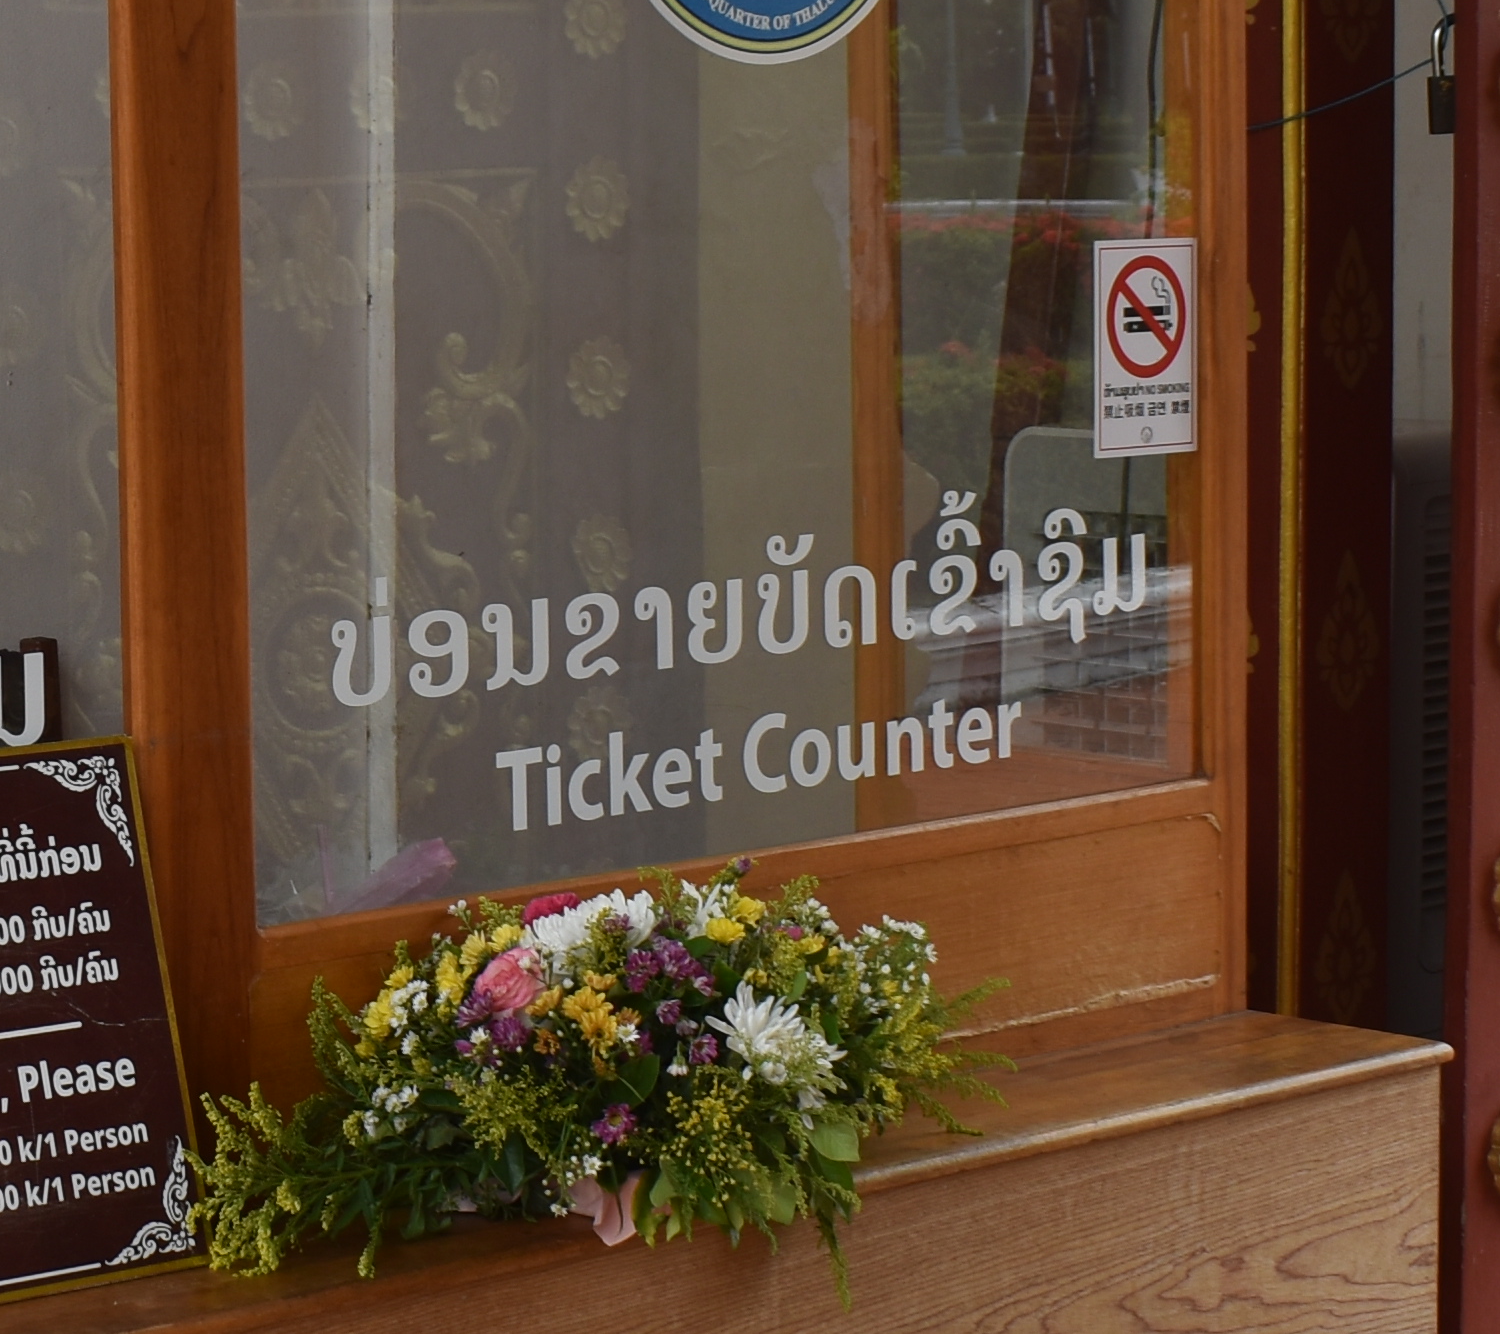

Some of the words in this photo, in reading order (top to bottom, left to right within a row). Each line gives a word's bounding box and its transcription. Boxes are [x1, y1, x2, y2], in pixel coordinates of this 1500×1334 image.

[772, 14, 792, 30] OF
[331, 490, 1146, 707] ບ່ອນຂາຍບັດເຂົ້າຊົມ
[495, 729, 722, 832] Ticket
[743, 698, 1022, 793] Counter
[32, 901, 111, 941] ກີບ/ຄົນ
[40, 950, 119, 991] ກີບ/ຄົນ
[16, 1056, 137, 1103] Please
[17, 1132, 58, 1163] k/1
[64, 1120, 149, 1155] Person
[24, 1176, 65, 1207] k/1
[71, 1164, 156, 1199] Person
